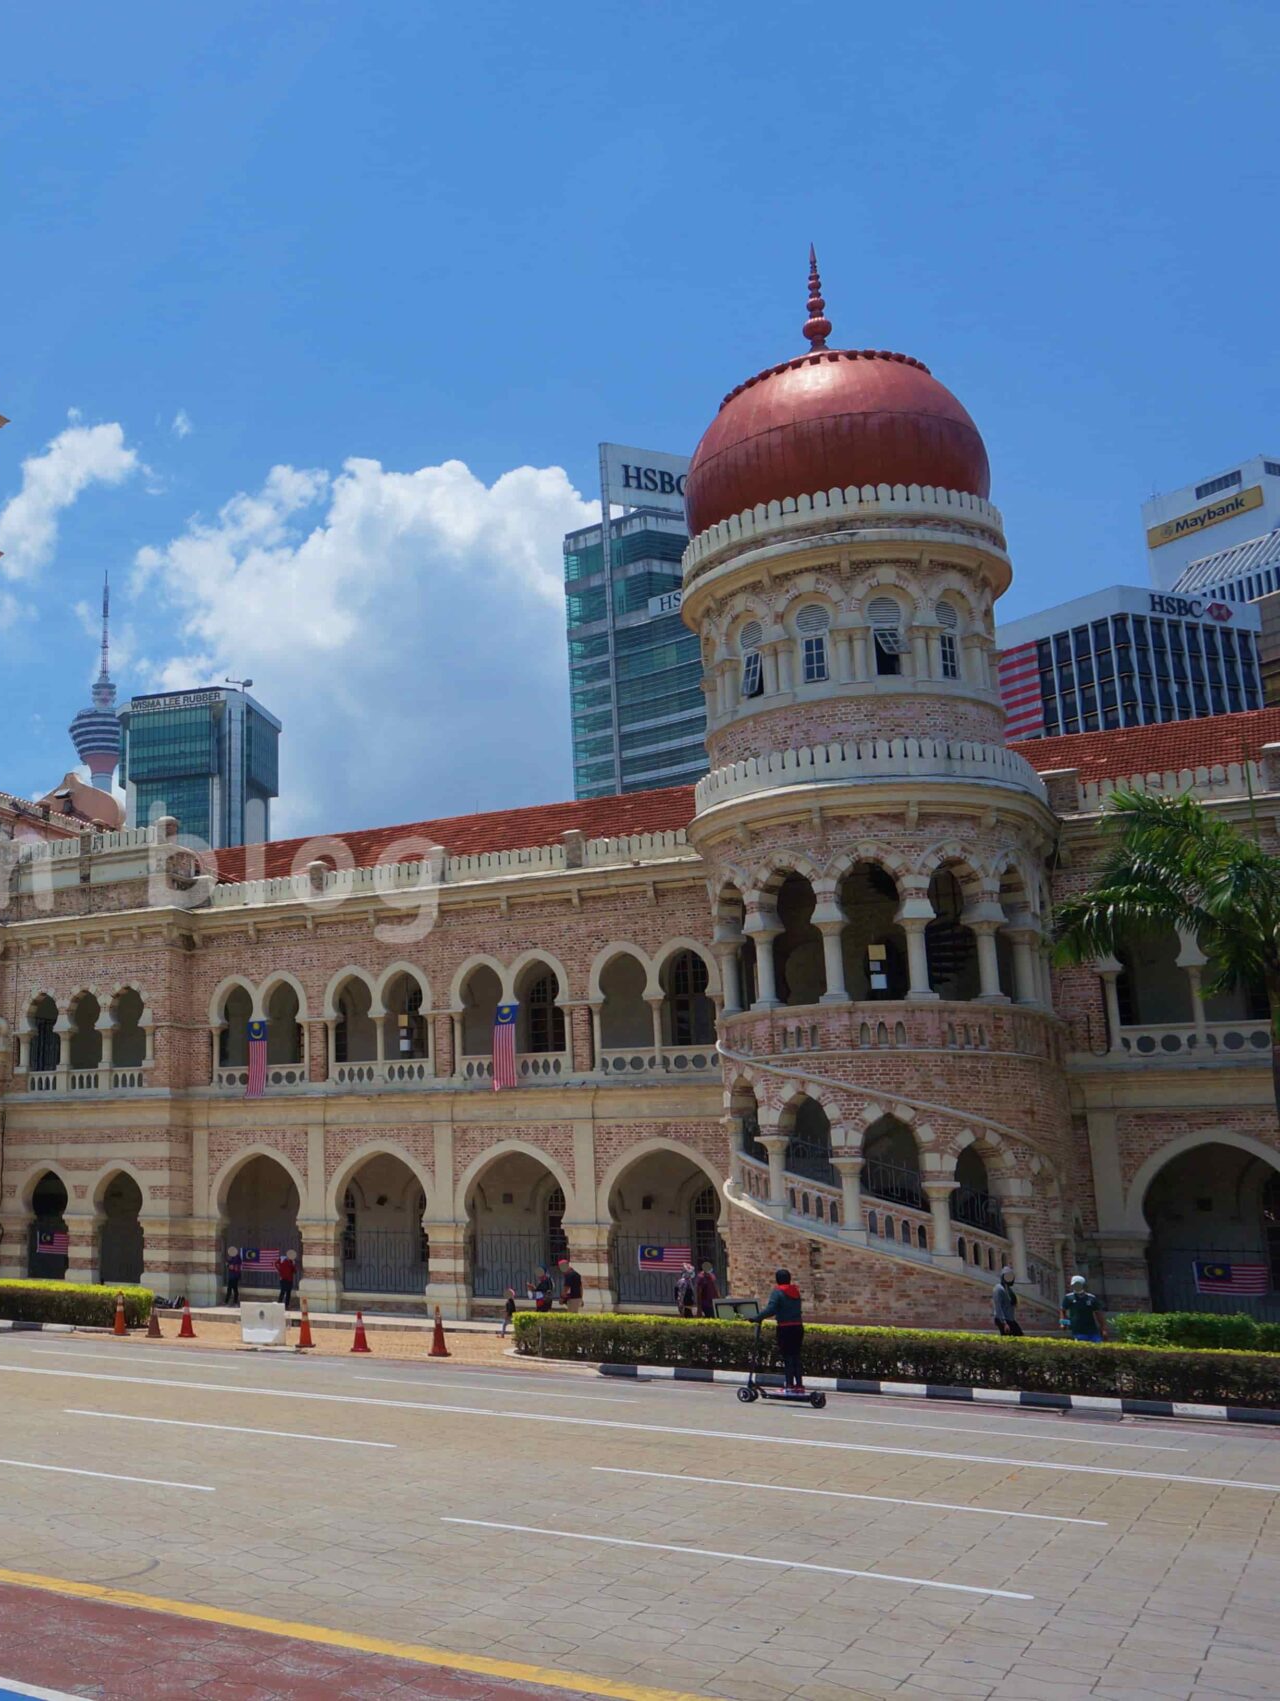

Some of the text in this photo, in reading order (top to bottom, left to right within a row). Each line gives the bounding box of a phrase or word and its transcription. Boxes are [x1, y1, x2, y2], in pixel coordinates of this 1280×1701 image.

[1175, 497, 1245, 534] Maybank
[1149, 593, 1204, 619] HSBC
[131, 691, 220, 710] WISMA LEE RUBBER
